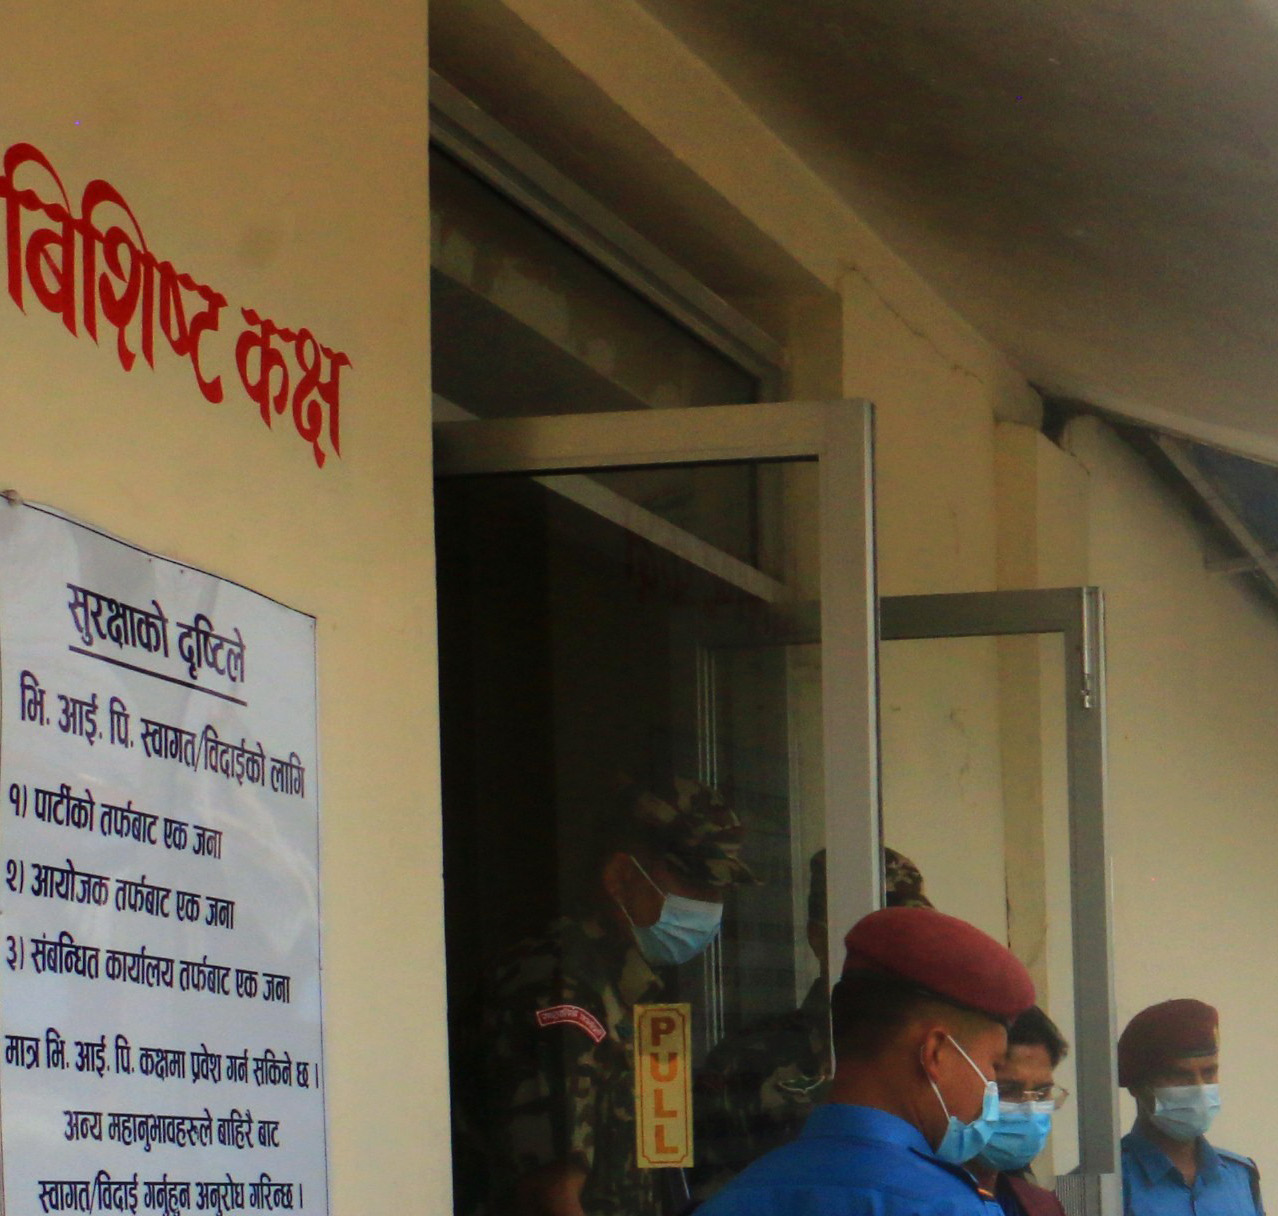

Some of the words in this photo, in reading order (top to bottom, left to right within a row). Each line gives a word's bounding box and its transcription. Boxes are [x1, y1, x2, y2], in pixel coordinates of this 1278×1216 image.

[235, 307, 353, 469] कक्ष
[66, 583, 169, 657] सुरक्षाको
[176, 613, 246, 683] दृष्टिले
[20, 670, 50, 726] भि.
[58, 693, 103, 746] आई.
[110, 696, 134, 748] पि.
[140, 718, 266, 786] स्वागत/विदाईको
[270, 752, 305, 798] लागि
[9, 783, 27, 818] १)
[34, 783, 95, 831] पार्टीको
[100, 801, 159, 845] तर्फबाट
[163, 818, 188, 850] एक
[193, 825, 223, 859] जना
[31, 859, 110, 906] आयोजक
[115, 875, 171, 917] तर्फबाट
[176, 891, 201, 922] एक
[205, 896, 235, 929] जना
[31, 931, 101, 980] संबन्धित
[105, 946, 174, 989] कार्यालय
[179, 956, 230, 995] तर्फबाट
[235, 969, 258, 999] एक
[263, 973, 290, 1003] जना
[5, 1035, 40, 1069] मात्र
[46, 1028, 69, 1070] भि.
[74, 1035, 109, 1078] आई.
[115, 1034, 134, 1074] पि.
[139, 1047, 186, 1081] कक्षमा
[190, 1043, 221, 1084] प्रवेश
[226, 1049, 249, 1084] गर्न
[253, 1049, 292, 1087] सकिने
[649, 1016, 679, 1155] PULL
[63, 1110, 102, 1141] अन्य
[217, 1108, 254, 1149] बाहिरै
[258, 1120, 280, 1148] बाट
[249, 1173, 293, 1211] गरिन्छ
